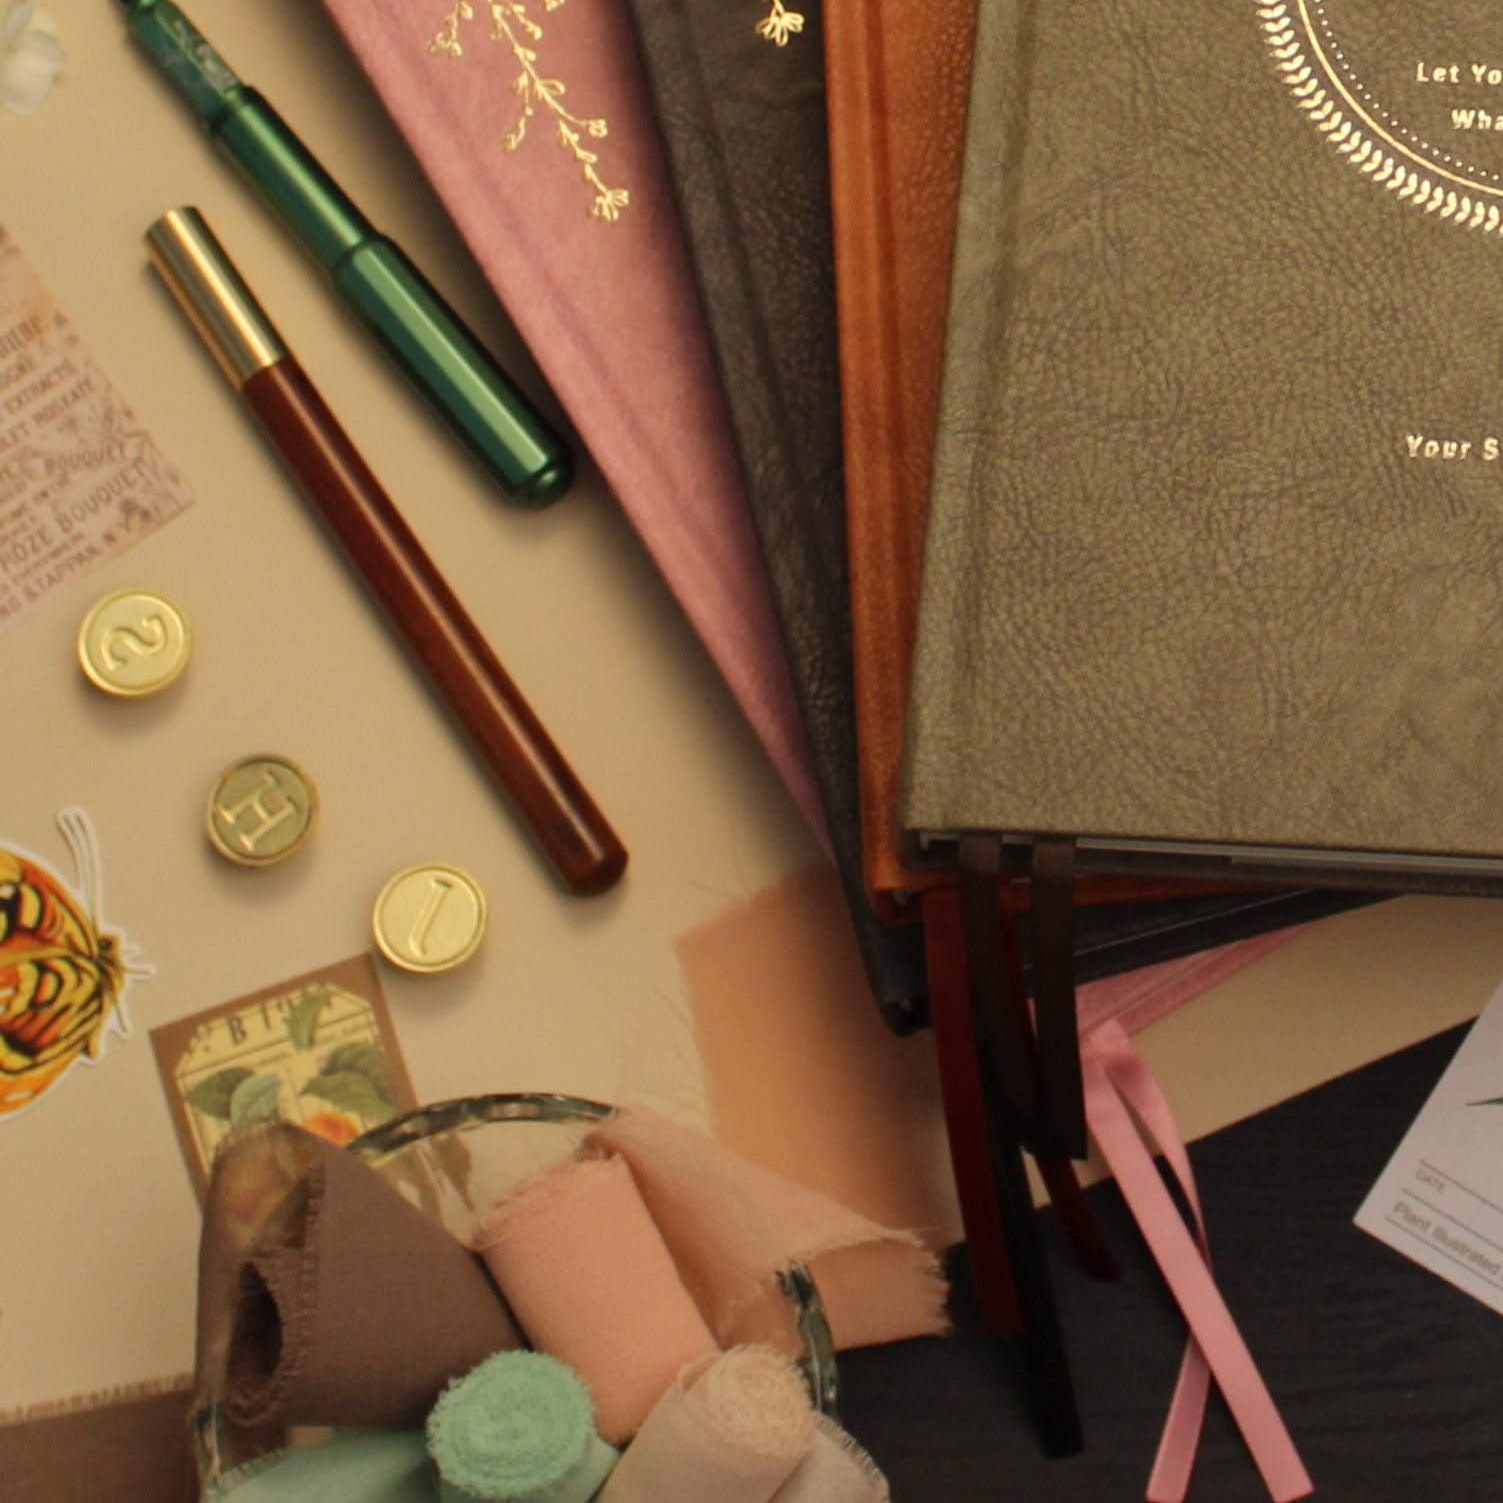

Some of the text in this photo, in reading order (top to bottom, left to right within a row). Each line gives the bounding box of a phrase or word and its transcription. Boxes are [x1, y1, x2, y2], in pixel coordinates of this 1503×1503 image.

[1416, 61, 1460, 84] Let
[44, 443, 124, 475] BOUQUET
[1406, 433, 1472, 460] Your
[57, 457, 147, 533] BOUQUET
[219, 768, 296, 853] H
[1415, 1168, 1446, 1194] DATE
[1392, 1201, 1432, 1234] Plant
[1432, 1226, 1502, 1276] Illustrated
